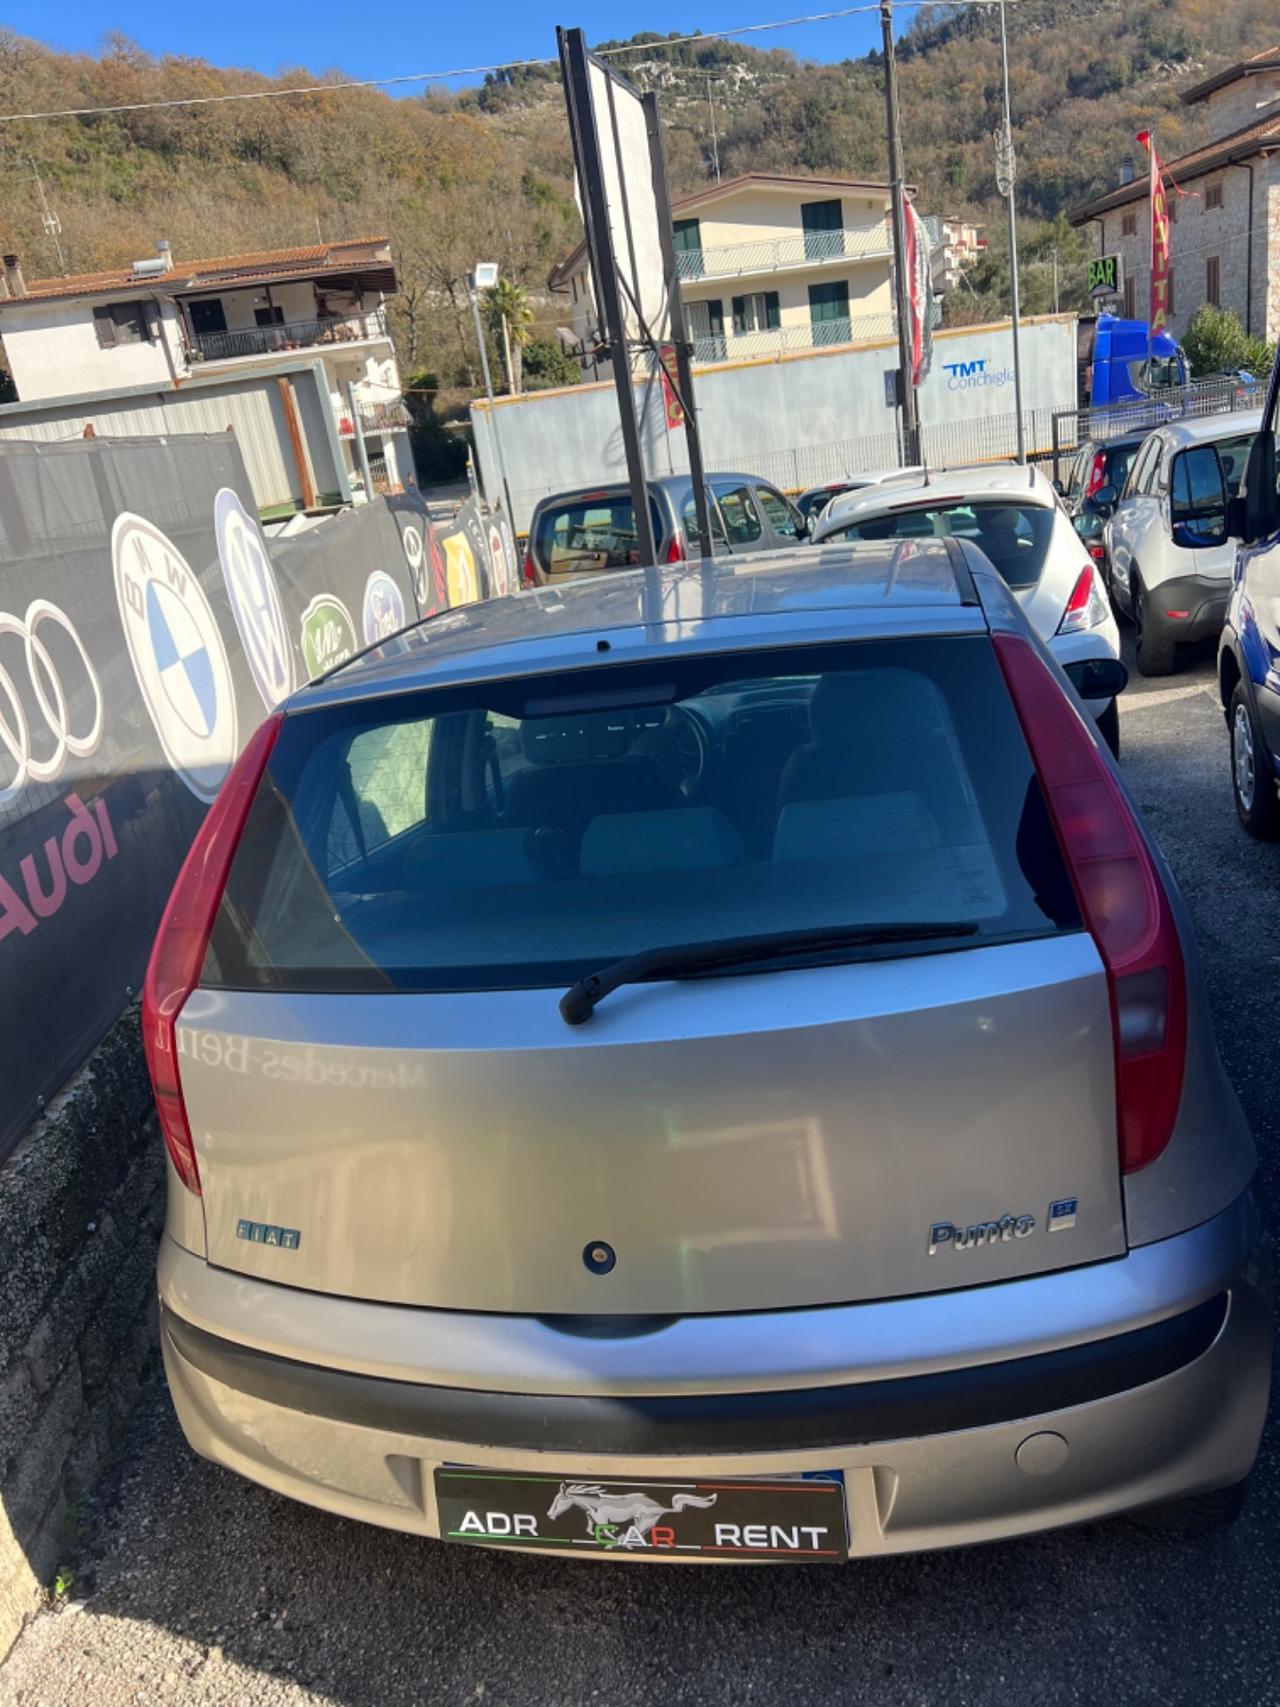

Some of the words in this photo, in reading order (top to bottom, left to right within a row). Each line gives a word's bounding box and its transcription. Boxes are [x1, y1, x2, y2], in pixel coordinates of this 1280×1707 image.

[1088, 259, 1115, 292] BAR
[942, 360, 985, 377] TMT
[124, 536, 187, 621] BMW
[238, 1221, 298, 1248] FIAT
[928, 1213, 1035, 1256] Punto
[459, 1511, 538, 1536] ADR
[595, 1525, 675, 1547] CAR
[714, 1523, 828, 1549] RENT
